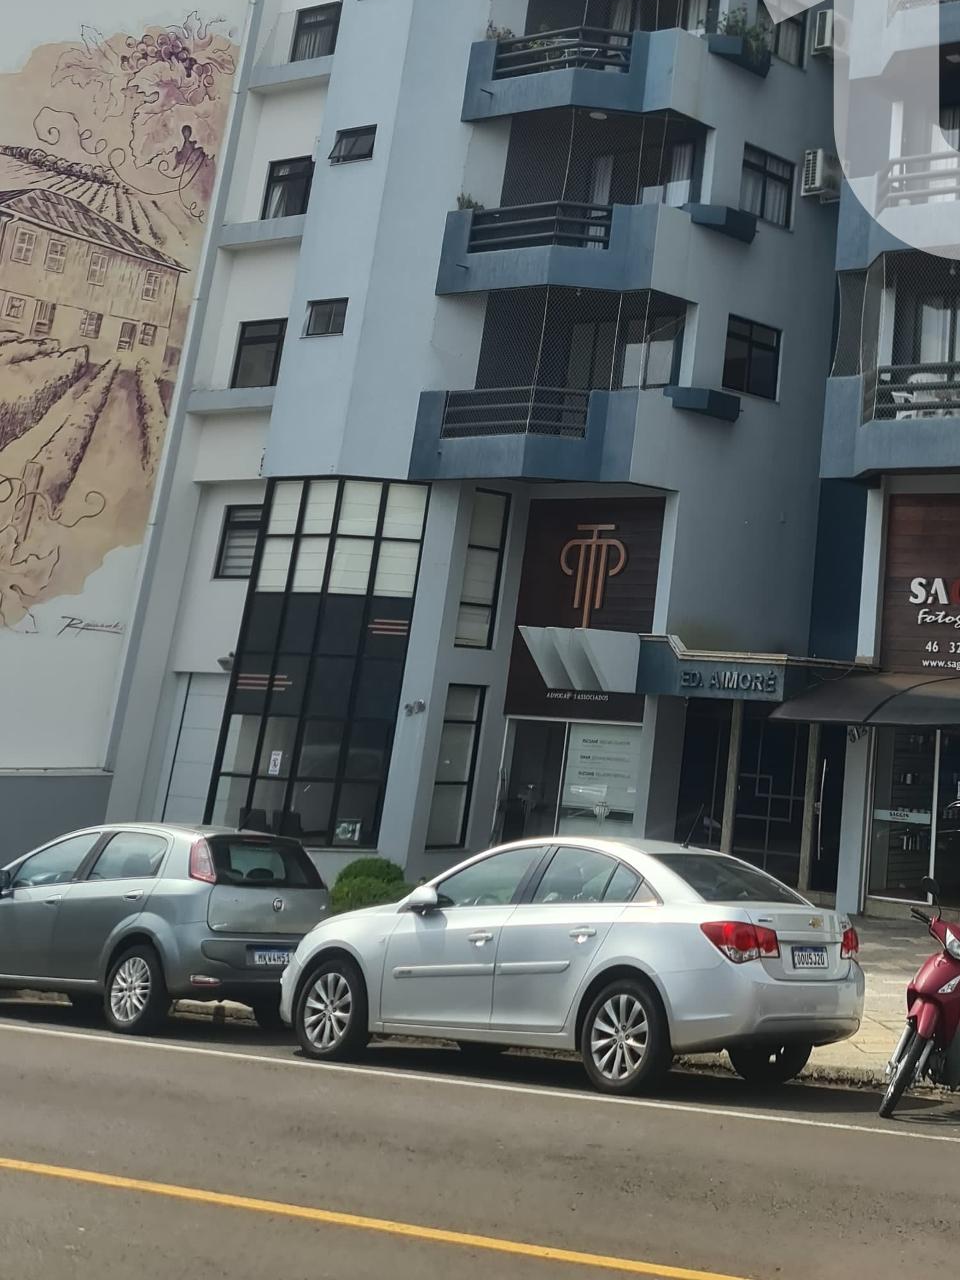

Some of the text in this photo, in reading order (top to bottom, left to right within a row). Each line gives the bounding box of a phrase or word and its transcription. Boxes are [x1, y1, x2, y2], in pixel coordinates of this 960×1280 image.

[925, 641, 939, 652] 46
[681, 669, 777, 693] ED. AIMORÉ
